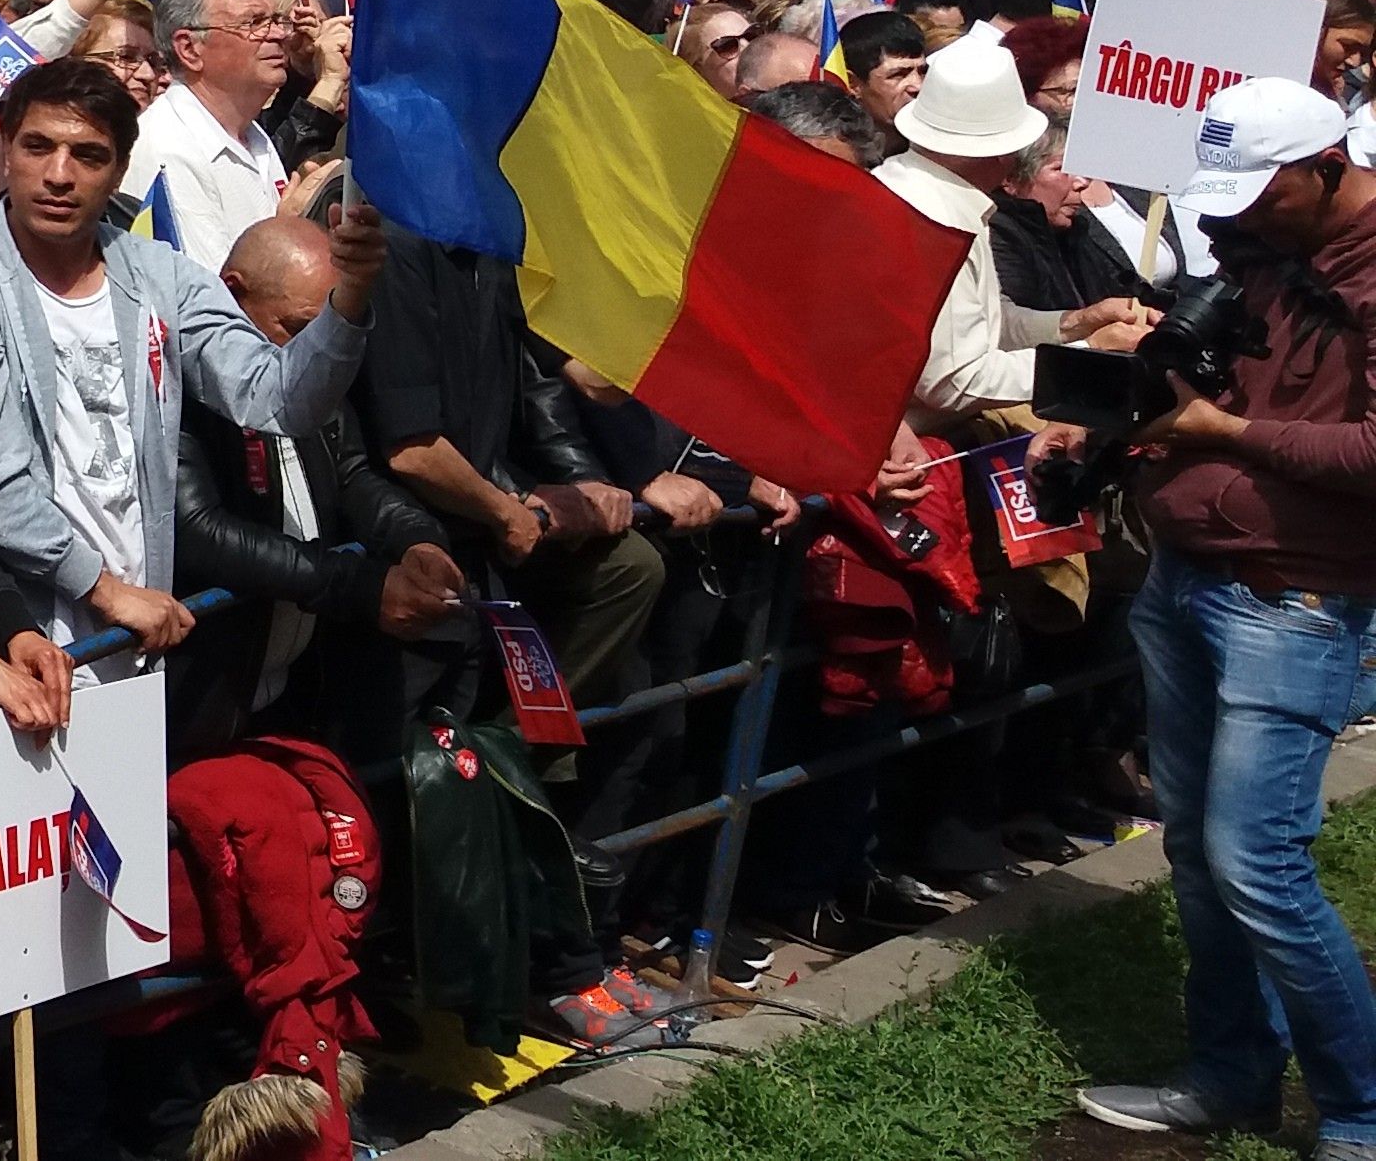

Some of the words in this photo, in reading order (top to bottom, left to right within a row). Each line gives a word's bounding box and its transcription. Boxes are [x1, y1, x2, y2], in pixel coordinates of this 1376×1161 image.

[1095, 39, 1195, 109] TÂRGU
[1003, 478, 1038, 524] PSD
[503, 638, 535, 693] PSD
